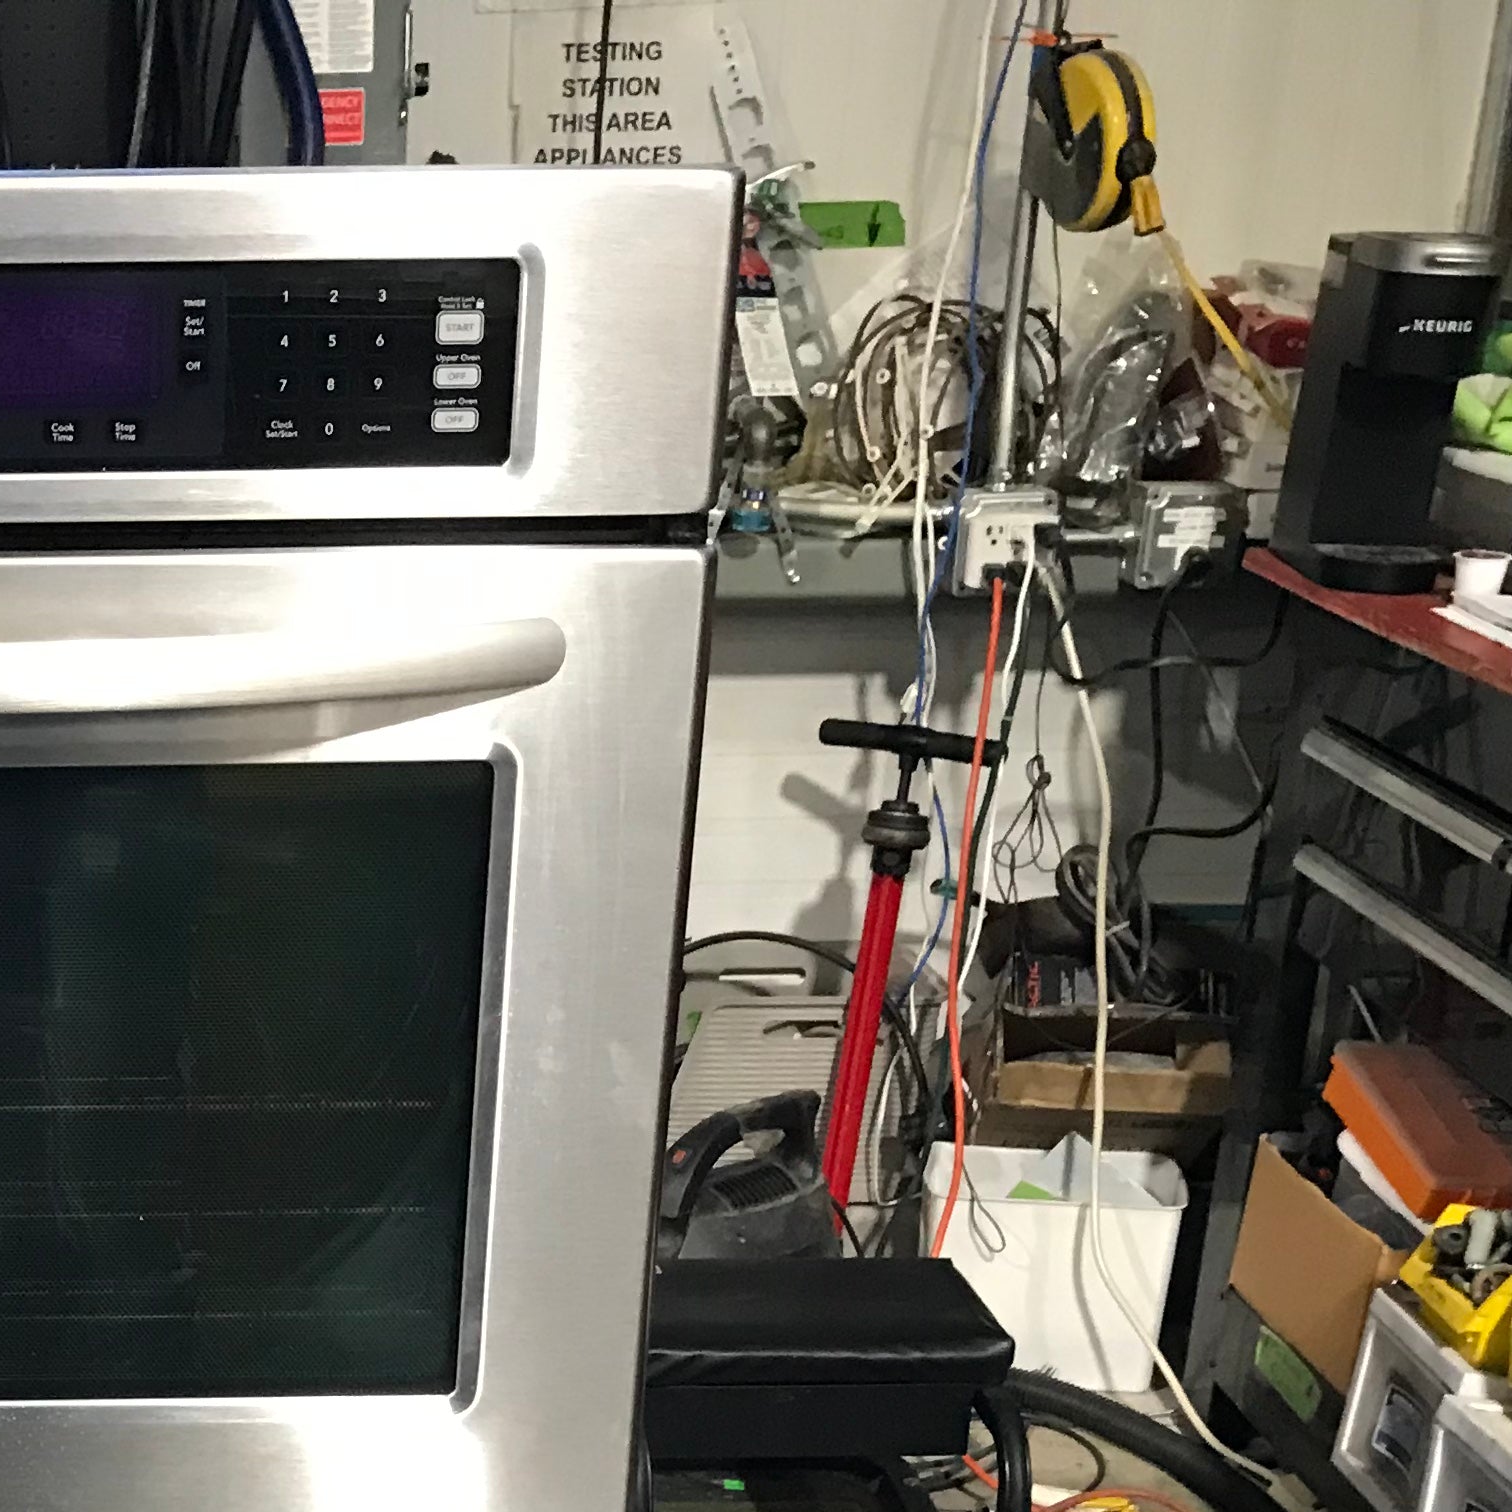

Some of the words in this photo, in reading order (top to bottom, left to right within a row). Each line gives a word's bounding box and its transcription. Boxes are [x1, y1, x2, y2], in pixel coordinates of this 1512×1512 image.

[561, 41, 663, 63] TESTING
[562, 76, 661, 98] STATION
[547, 112, 598, 133] THIS
[606, 110, 673, 132] AREA
[282, 289, 289, 303] 1
[329, 289, 338, 303] 2
[378, 288, 387, 302] 3
[445, 323, 474, 332] START
[1412, 319, 1473, 332] KEURIG
[280, 334, 289, 348] 4
[328, 334, 337, 348] 5
[375, 333, 385, 347] 6
[185, 360, 201, 371] Off
[447, 372, 466, 381] OFF
[279, 378, 288, 392] 7
[326, 377, 335, 391] 8
[373, 377, 383, 391] 9
[445, 416, 464, 424] OFF
[50, 422, 75, 432] Cook
[114, 421, 136, 433] Stop
[324, 422, 334, 436] 0
[52, 432, 74, 442] Time
[115, 432, 136, 441] Time
